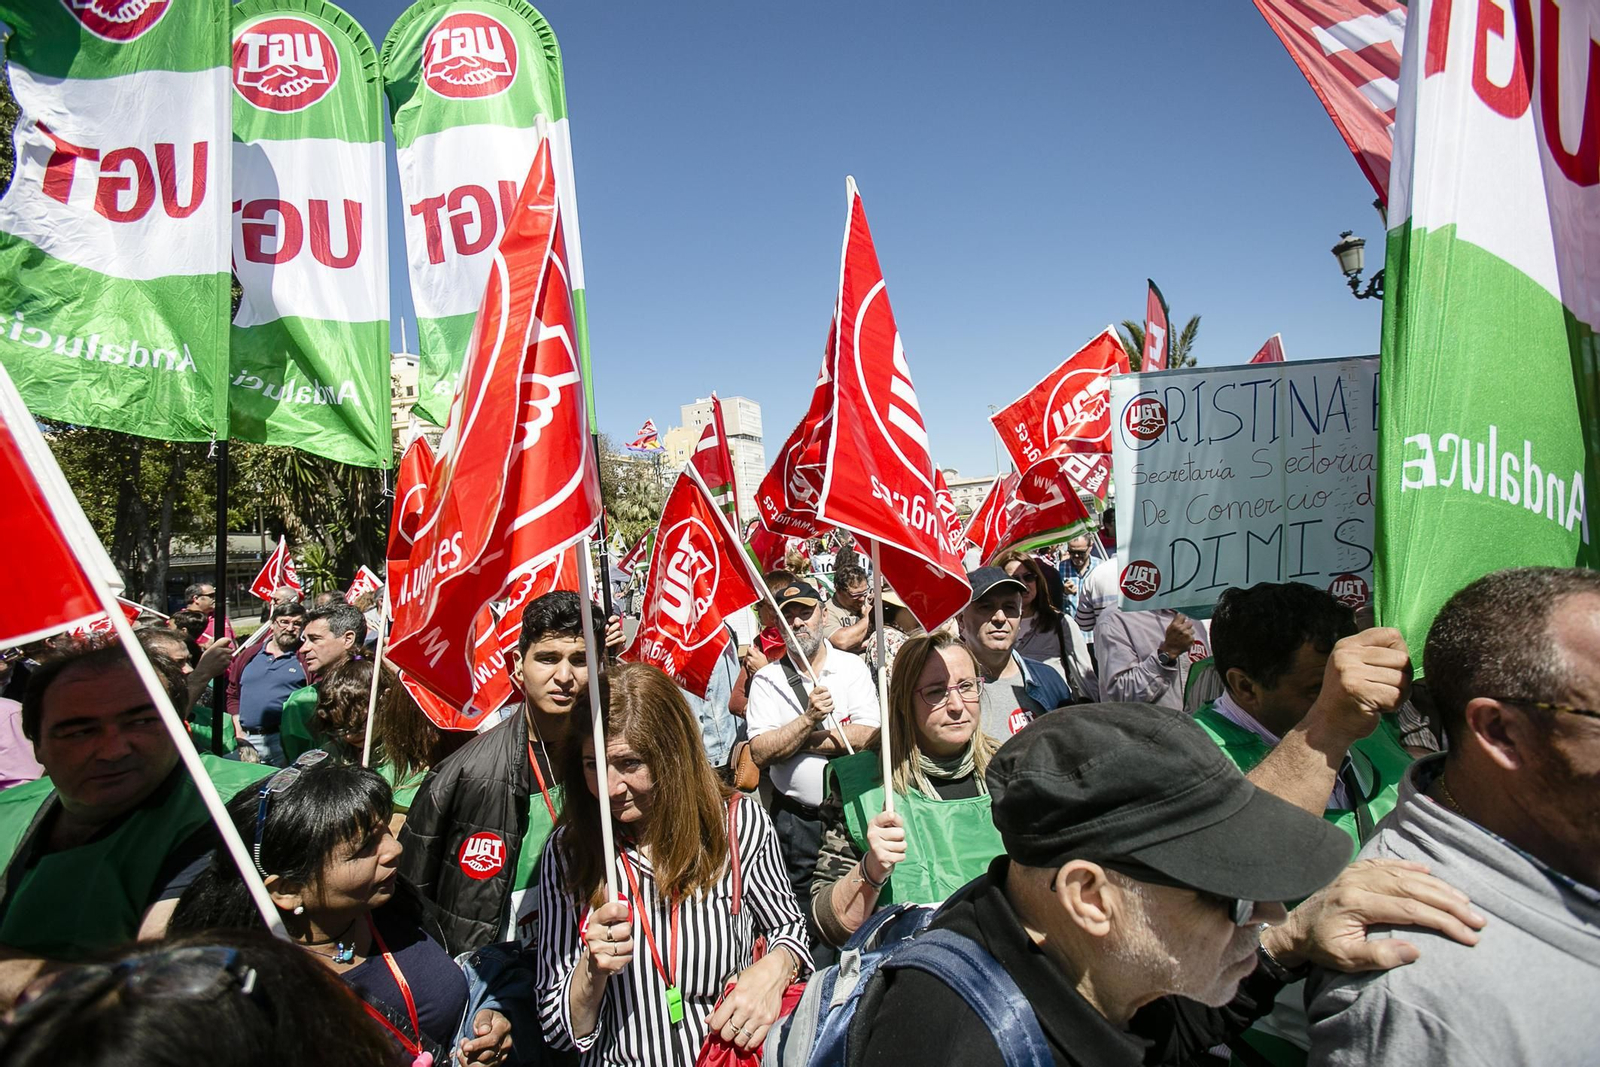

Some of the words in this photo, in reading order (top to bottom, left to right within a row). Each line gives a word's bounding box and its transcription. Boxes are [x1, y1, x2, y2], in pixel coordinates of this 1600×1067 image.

[1120, 376, 1351, 450] CRISTINA
[1130, 403, 1163, 420] UGT
[1250, 437, 1378, 479] Sectoria
[1142, 499, 1170, 527] De
[1159, 518, 1373, 597] DIMIS
[1127, 565, 1158, 583] UGT
[1332, 580, 1363, 596] UGT
[465, 838, 502, 859] UGT
